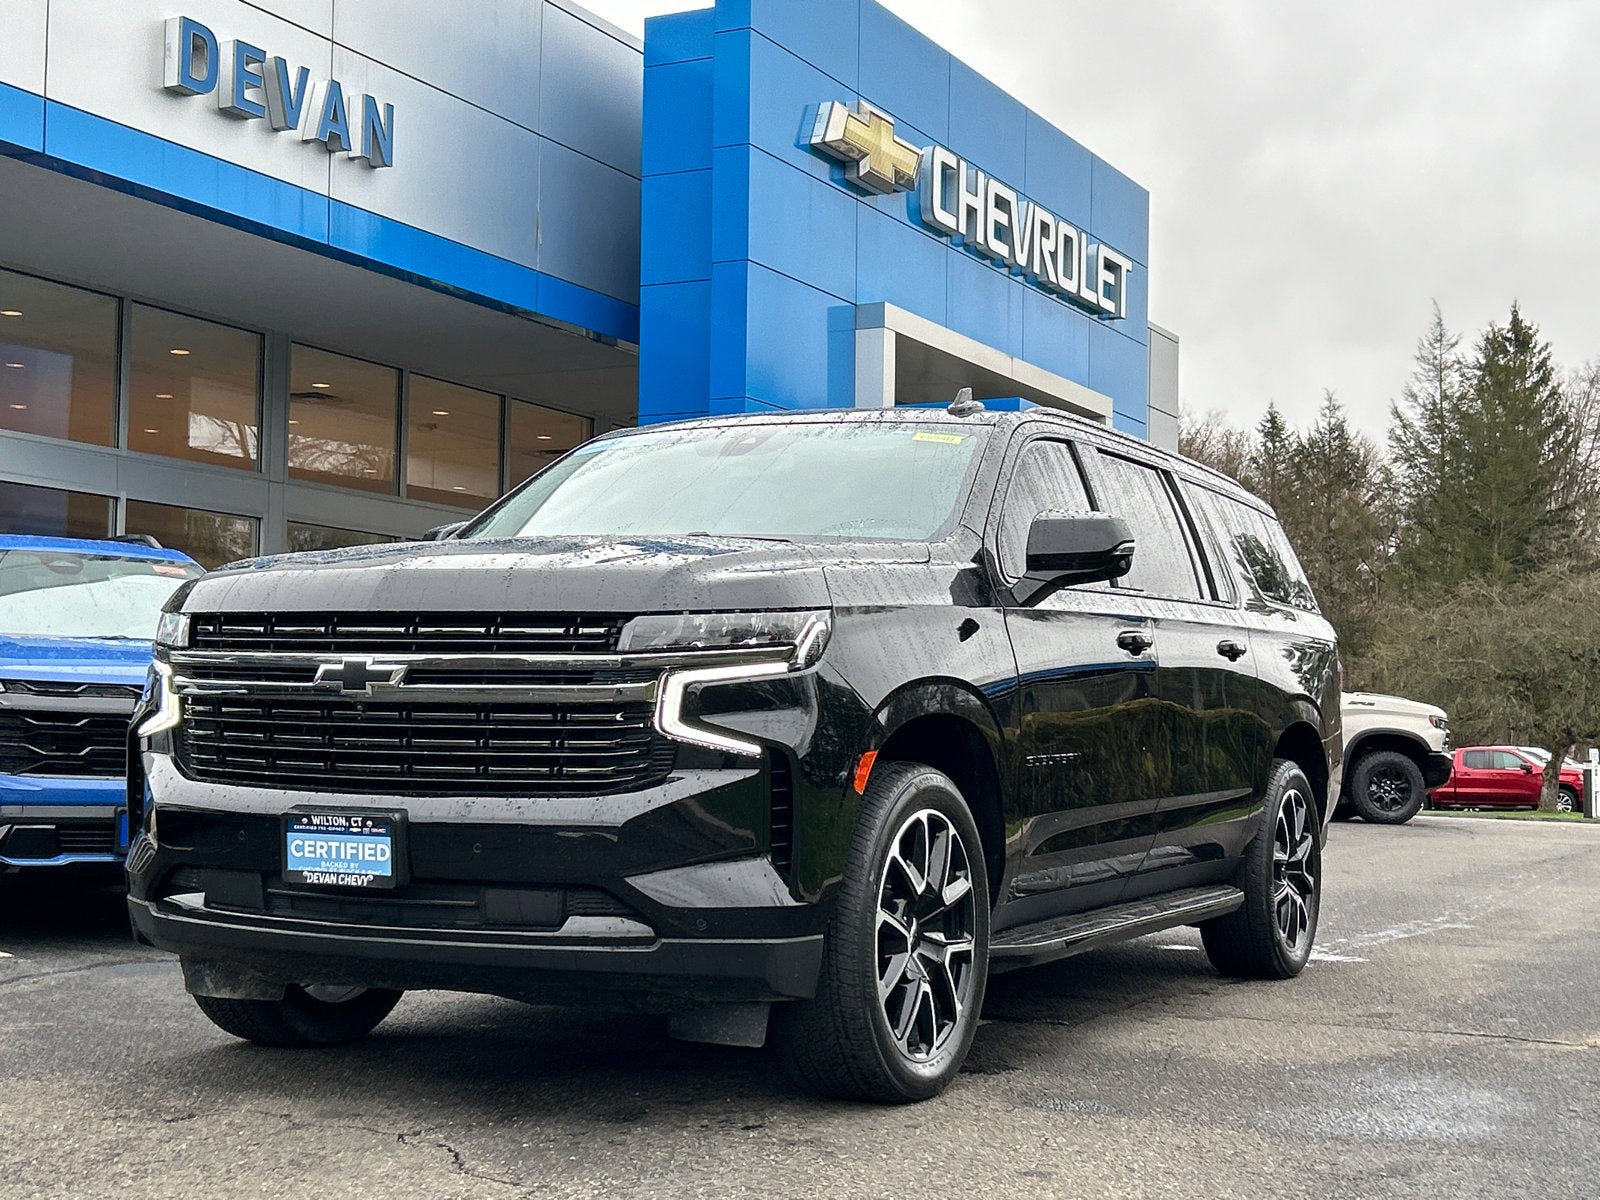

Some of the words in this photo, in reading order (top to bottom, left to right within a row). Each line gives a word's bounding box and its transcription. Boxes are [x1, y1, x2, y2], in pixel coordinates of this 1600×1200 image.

[165, 16, 395, 169] DEVAN
[924, 145, 1133, 320] CHEVROLET
[311, 815, 349, 827] WILTON,
[351, 817, 363, 827] CT
[290, 839, 390, 862] CERTIFIED
[306, 872, 336, 884] DEVAN
[338, 874, 369, 886] CHEVY
